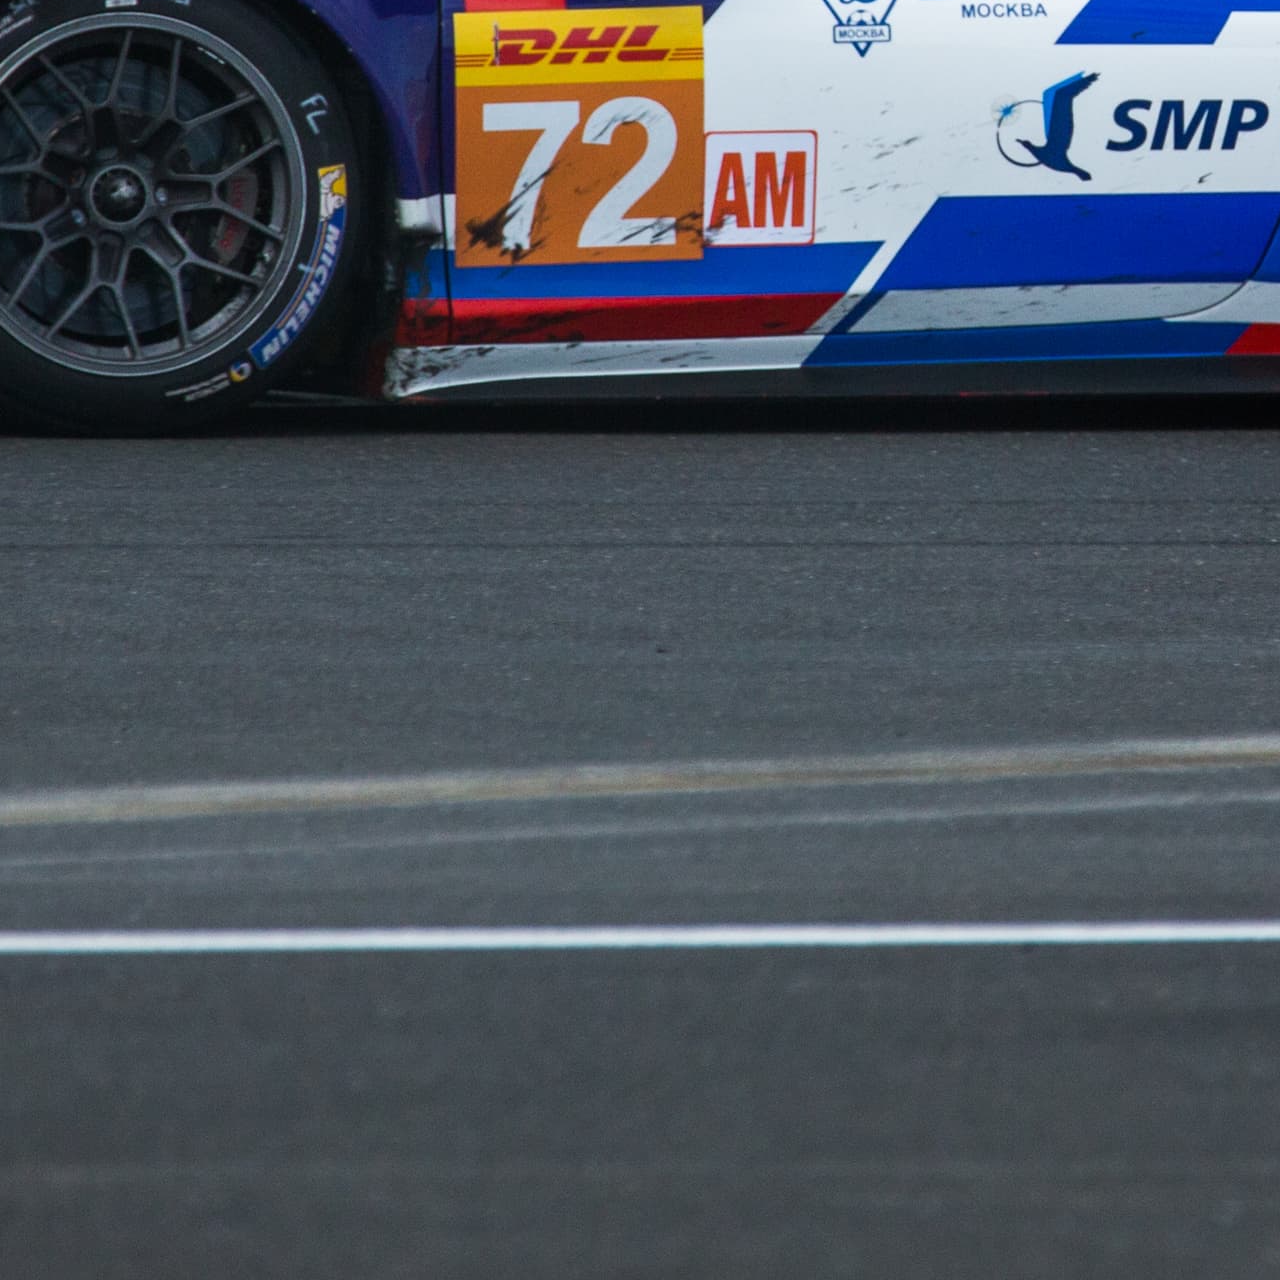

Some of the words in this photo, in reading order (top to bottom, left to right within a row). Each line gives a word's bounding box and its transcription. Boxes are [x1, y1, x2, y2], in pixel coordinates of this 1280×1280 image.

[838, 28, 886, 38] МОСКВА
[961, 3, 1048, 19] МОСКВА
[489, 24, 671, 67] DHL
[1105, 98, 1269, 152] SMP
[482, 96, 678, 251] 72
[708, 152, 807, 229] AM
[261, 223, 341, 362] MICHELIN
